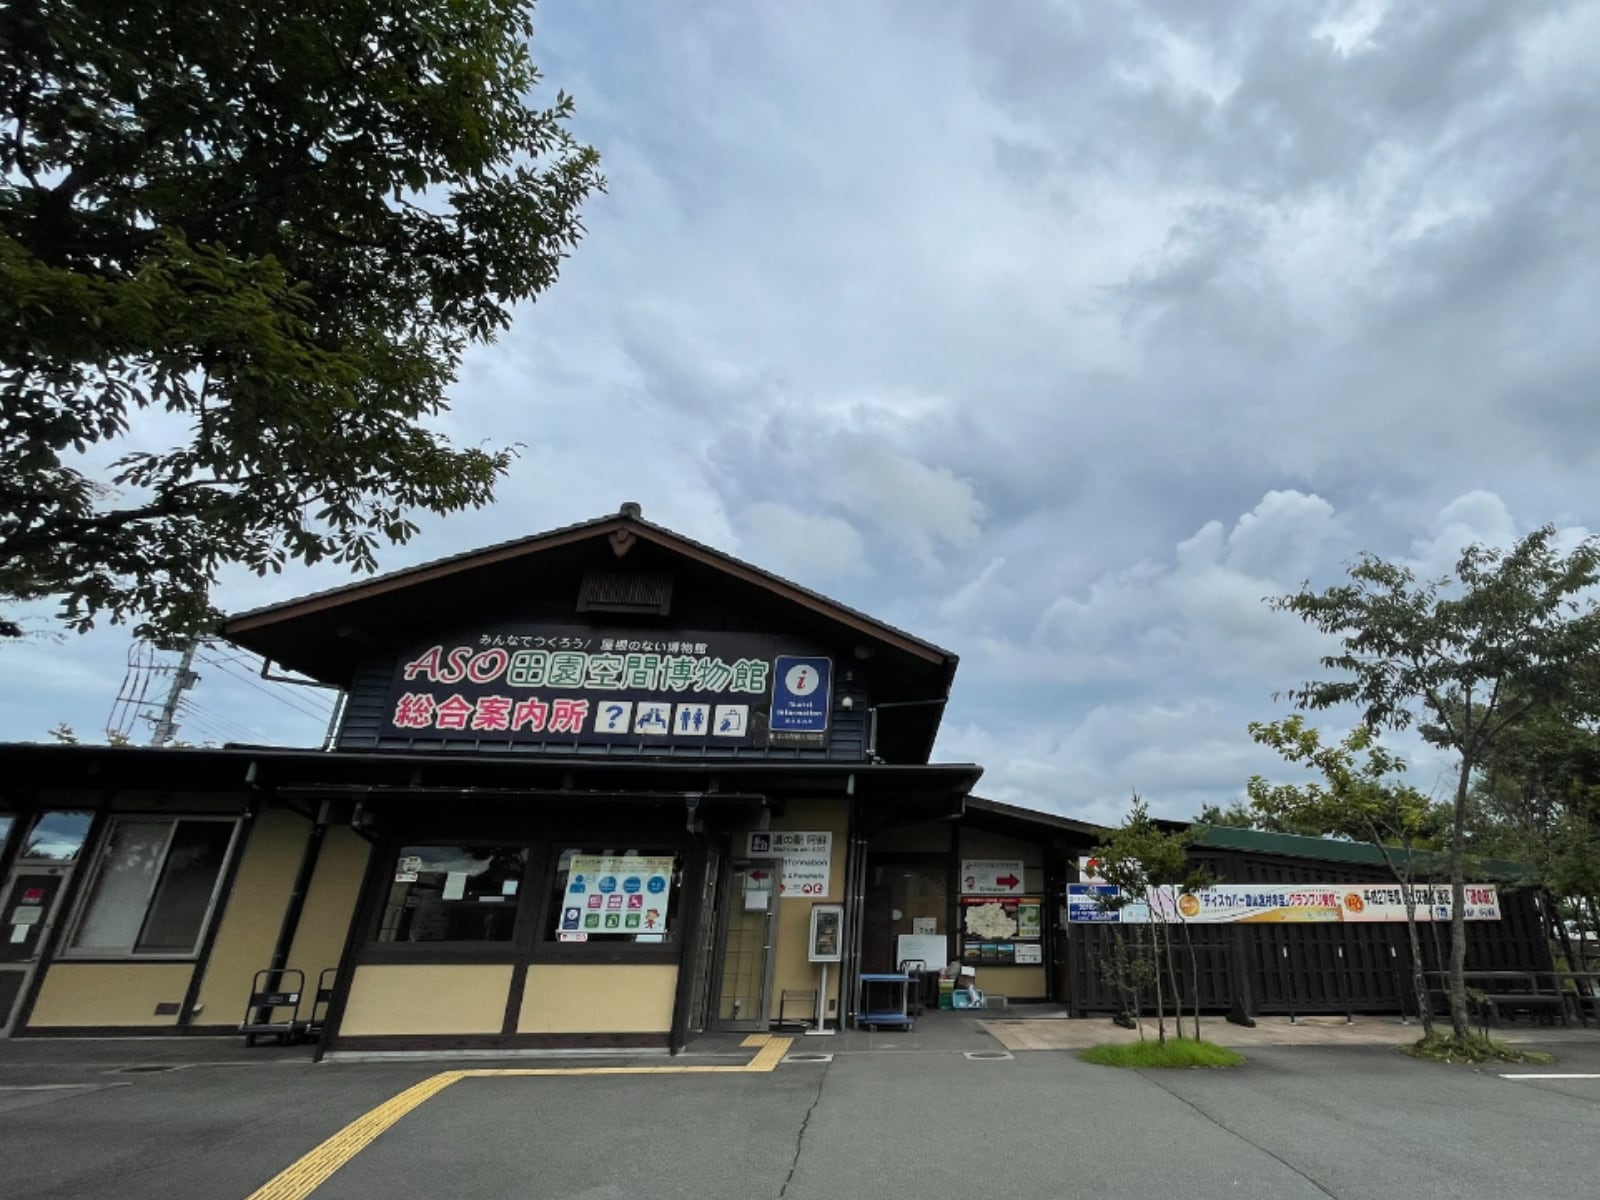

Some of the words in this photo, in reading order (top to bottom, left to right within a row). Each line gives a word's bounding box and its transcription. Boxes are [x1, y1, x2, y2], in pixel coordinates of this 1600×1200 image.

[600, 638, 708, 654] 屋根のない博物館
[391, 692, 589, 734] 総合案内所
[776, 709, 822, 717] Information
